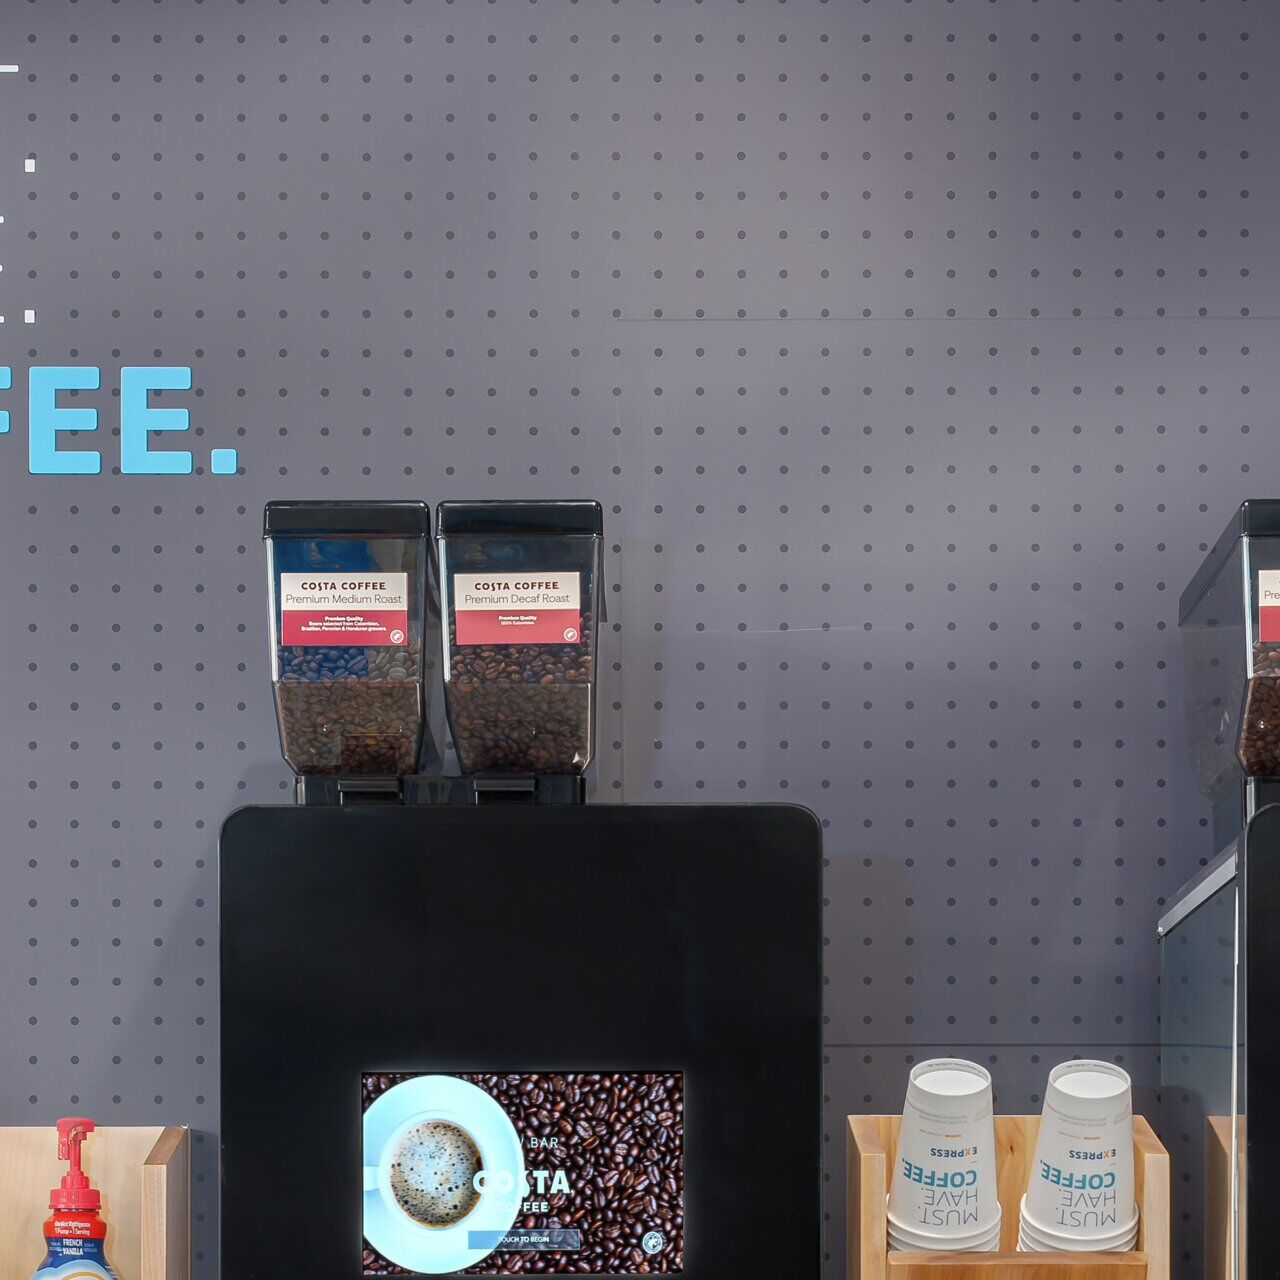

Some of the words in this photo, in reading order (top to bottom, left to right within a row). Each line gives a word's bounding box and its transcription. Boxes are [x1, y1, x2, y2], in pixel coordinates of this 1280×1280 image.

[301, 582, 337, 591] COSTA
[341, 582, 386, 590] COFFEE
[474, 582, 510, 591] COSTA
[514, 582, 560, 590] COFFEE
[285, 594, 329, 604] Premium
[332, 594, 372, 604] Medium
[374, 594, 402, 604] Roast
[465, 594, 508, 604] Premium
[511, 594, 540, 604] Decaf
[542, 594, 570, 603] Roast
[530, 1138, 558, 1148] BAR
[930, 1146, 977, 1158] EXPRESS
[1069, 1148, 1116, 1160] EXPRESS
[902, 1158, 977, 1188] COFFEE.
[1040, 1159, 1116, 1189] COFFEE.
[472, 1170, 571, 1197] COSTA
[921, 1187, 978, 1206] HAVE.
[1058, 1188, 1116, 1208] HAVE.
[919, 1206, 978, 1226] MUST.
[1056, 1207, 1116, 1227] MUST.
